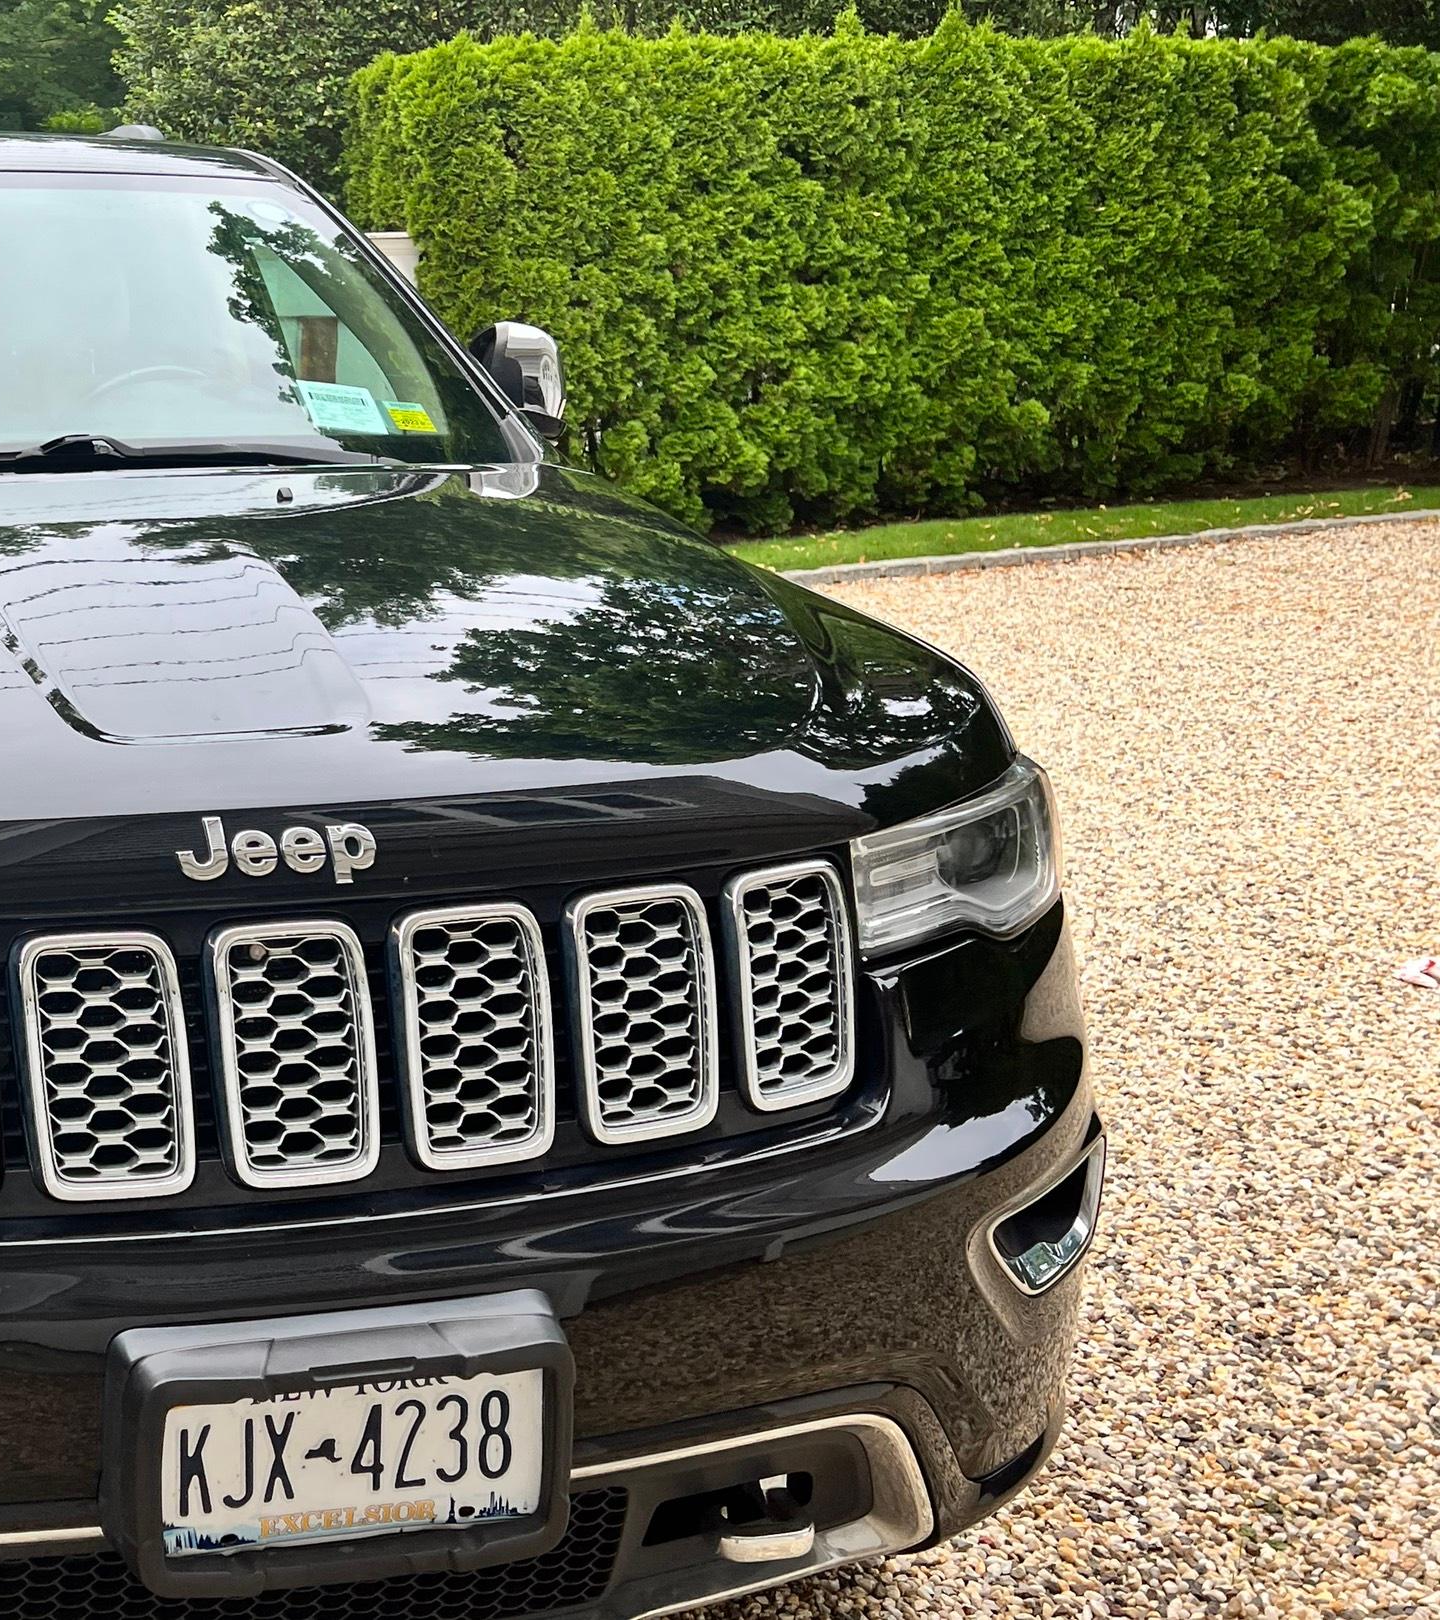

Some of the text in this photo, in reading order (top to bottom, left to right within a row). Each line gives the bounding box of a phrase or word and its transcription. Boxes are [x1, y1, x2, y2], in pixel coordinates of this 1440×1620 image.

[175, 815, 377, 885] Jeep
[178, 1389, 513, 1518] KJX 4238
[259, 1499, 437, 1538] EXCELSIOR
